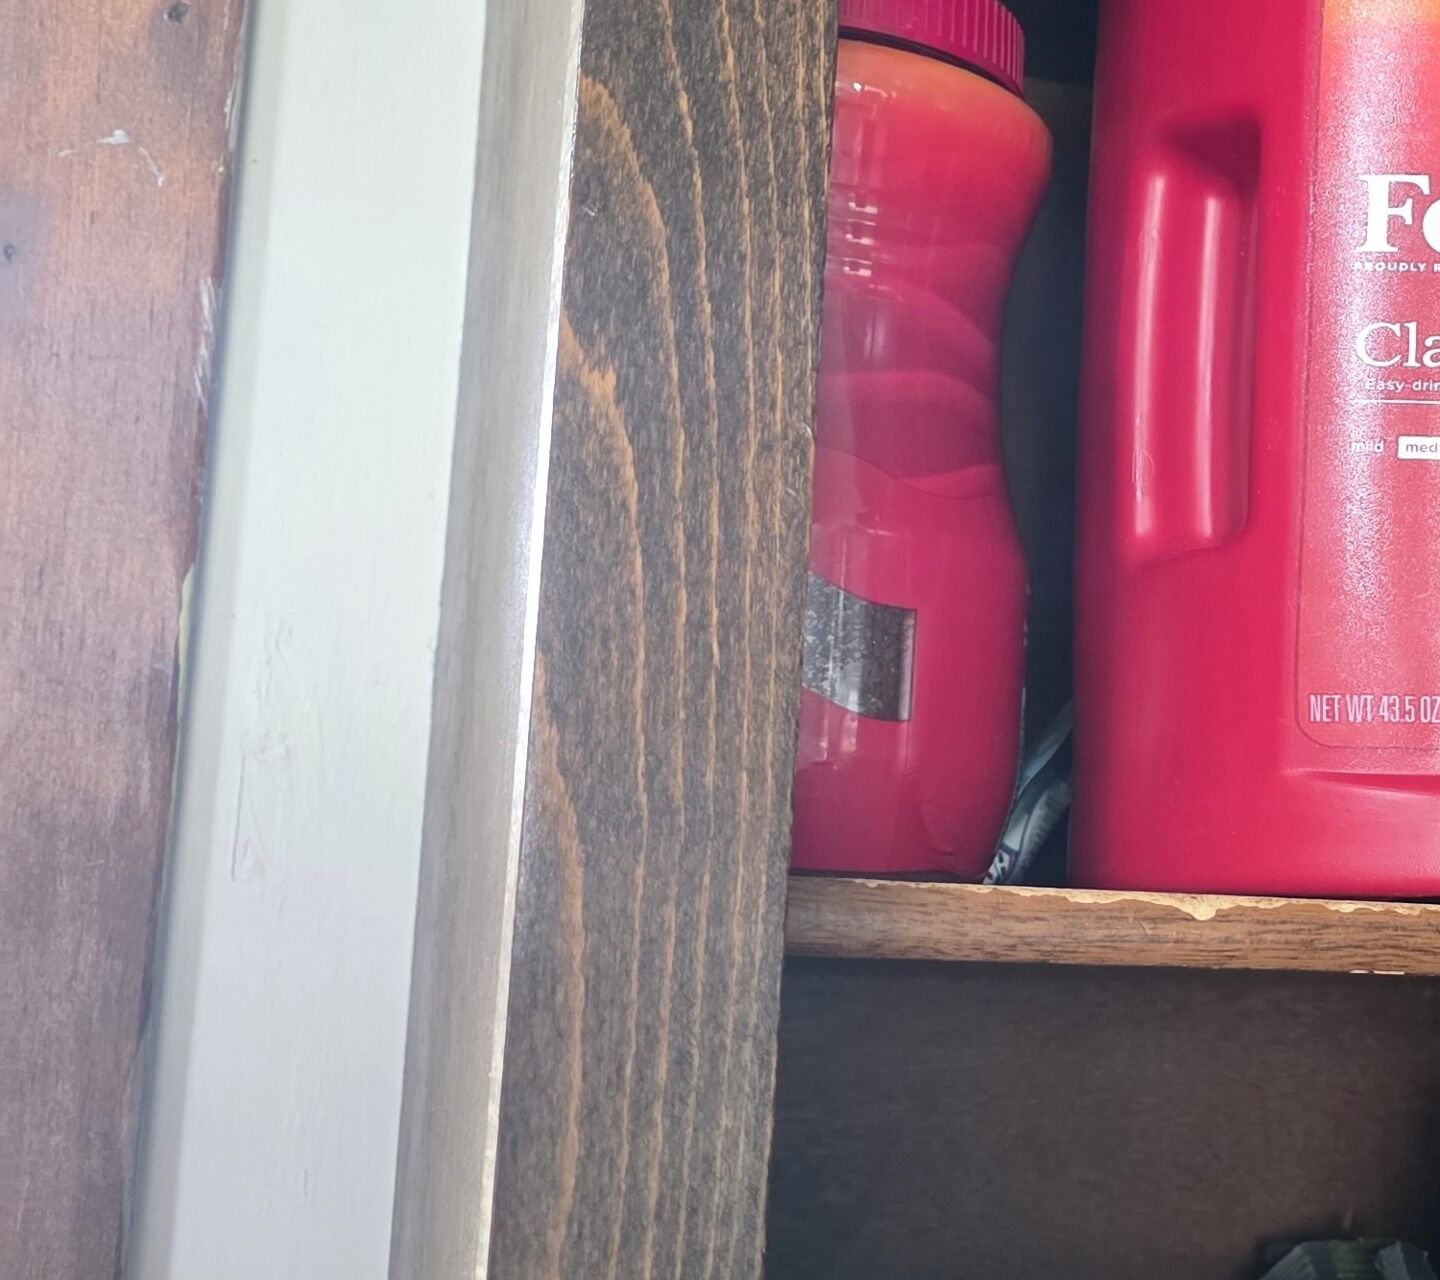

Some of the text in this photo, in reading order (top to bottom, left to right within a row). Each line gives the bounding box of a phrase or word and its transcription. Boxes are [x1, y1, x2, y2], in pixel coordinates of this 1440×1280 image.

[1310, 694, 1342, 722] NET
[1345, 694, 1372, 722] WT
[1378, 694, 1415, 723] 43.5
